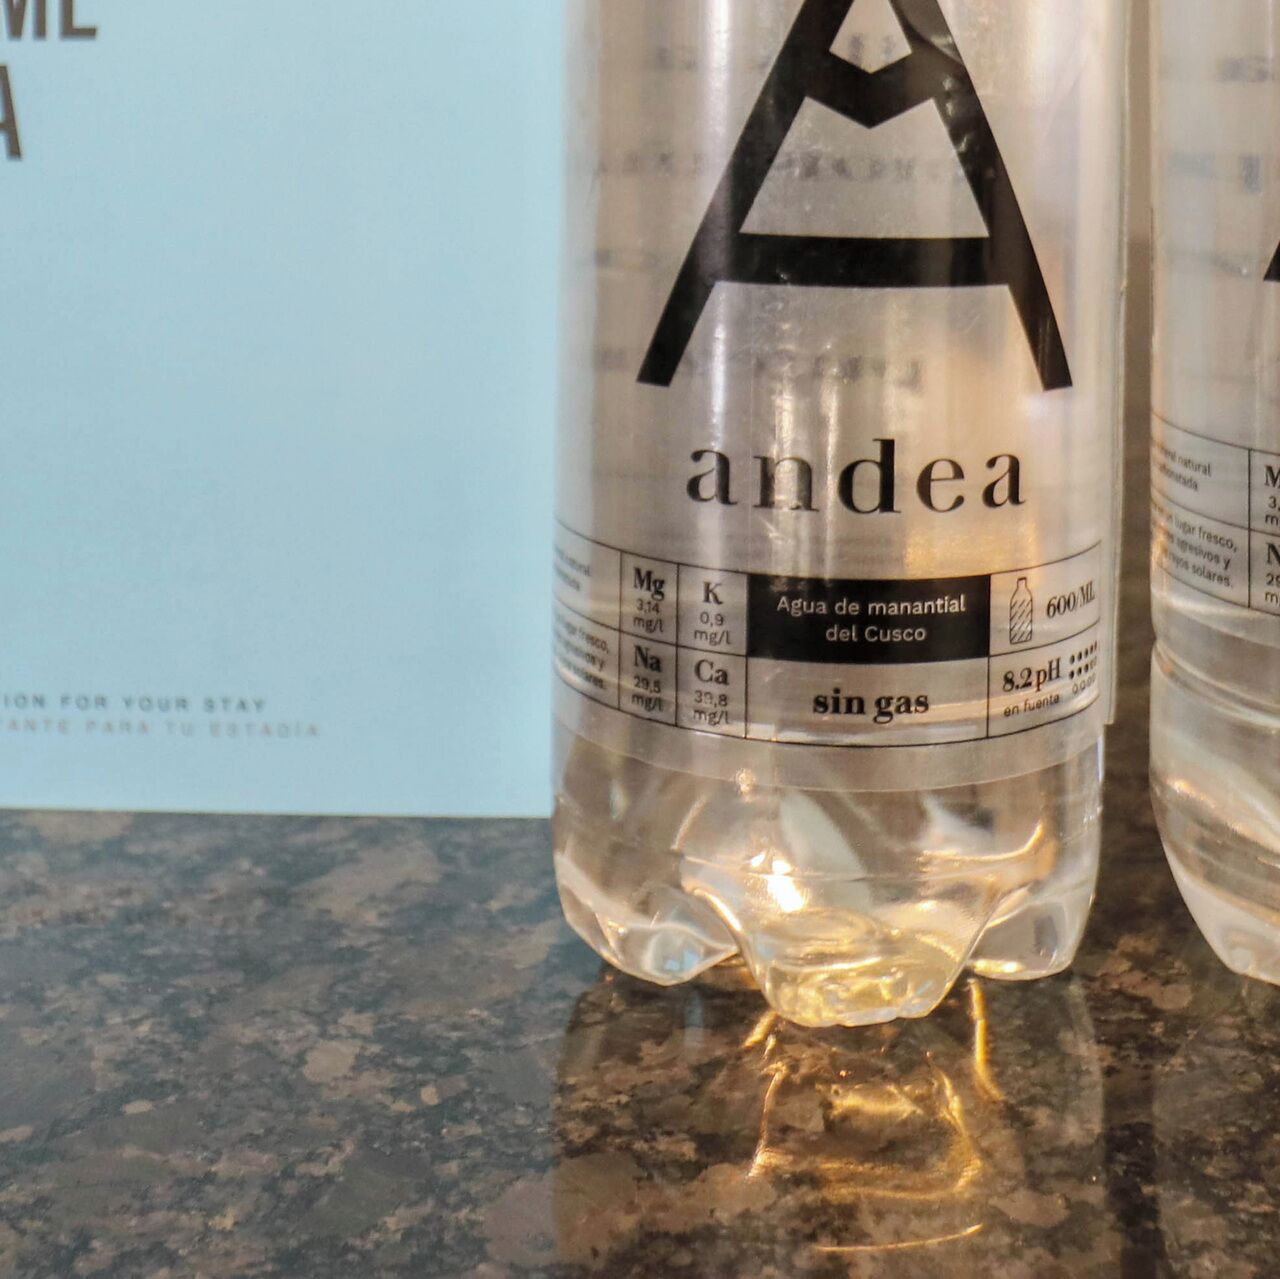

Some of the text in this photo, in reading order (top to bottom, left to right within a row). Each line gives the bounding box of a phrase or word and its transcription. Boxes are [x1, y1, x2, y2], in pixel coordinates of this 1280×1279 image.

[686, 438, 1026, 514] andea
[1198, 526, 1238, 554] fresco,
[1223, 557, 1231, 571] y
[633, 567, 665, 602] Mg
[702, 581, 724, 605] K
[636, 598, 660, 614] 3,14
[777, 594, 967, 617] Agua de manantial
[1046, 580, 1096, 619] 600/ML
[632, 615, 664, 633] mg/l
[699, 611, 725, 628] 0,9
[693, 629, 731, 646] mg/l
[825, 624, 927, 642] del Cusco
[633, 644, 663, 672] Na
[694, 658, 730, 686] Ca
[633, 676, 662, 695] 29,5
[59, 694, 108, 711] FOR
[123, 696, 189, 713] YOUR
[204, 696, 266, 714] STAY
[631, 693, 664, 713] mg/l
[812, 687, 930, 724] sin gas
[1003, 693, 1060, 718] en fuente
[692, 708, 729, 726] mg/l
[85, 719, 150, 735] PARA
[167, 719, 195, 737] TU
